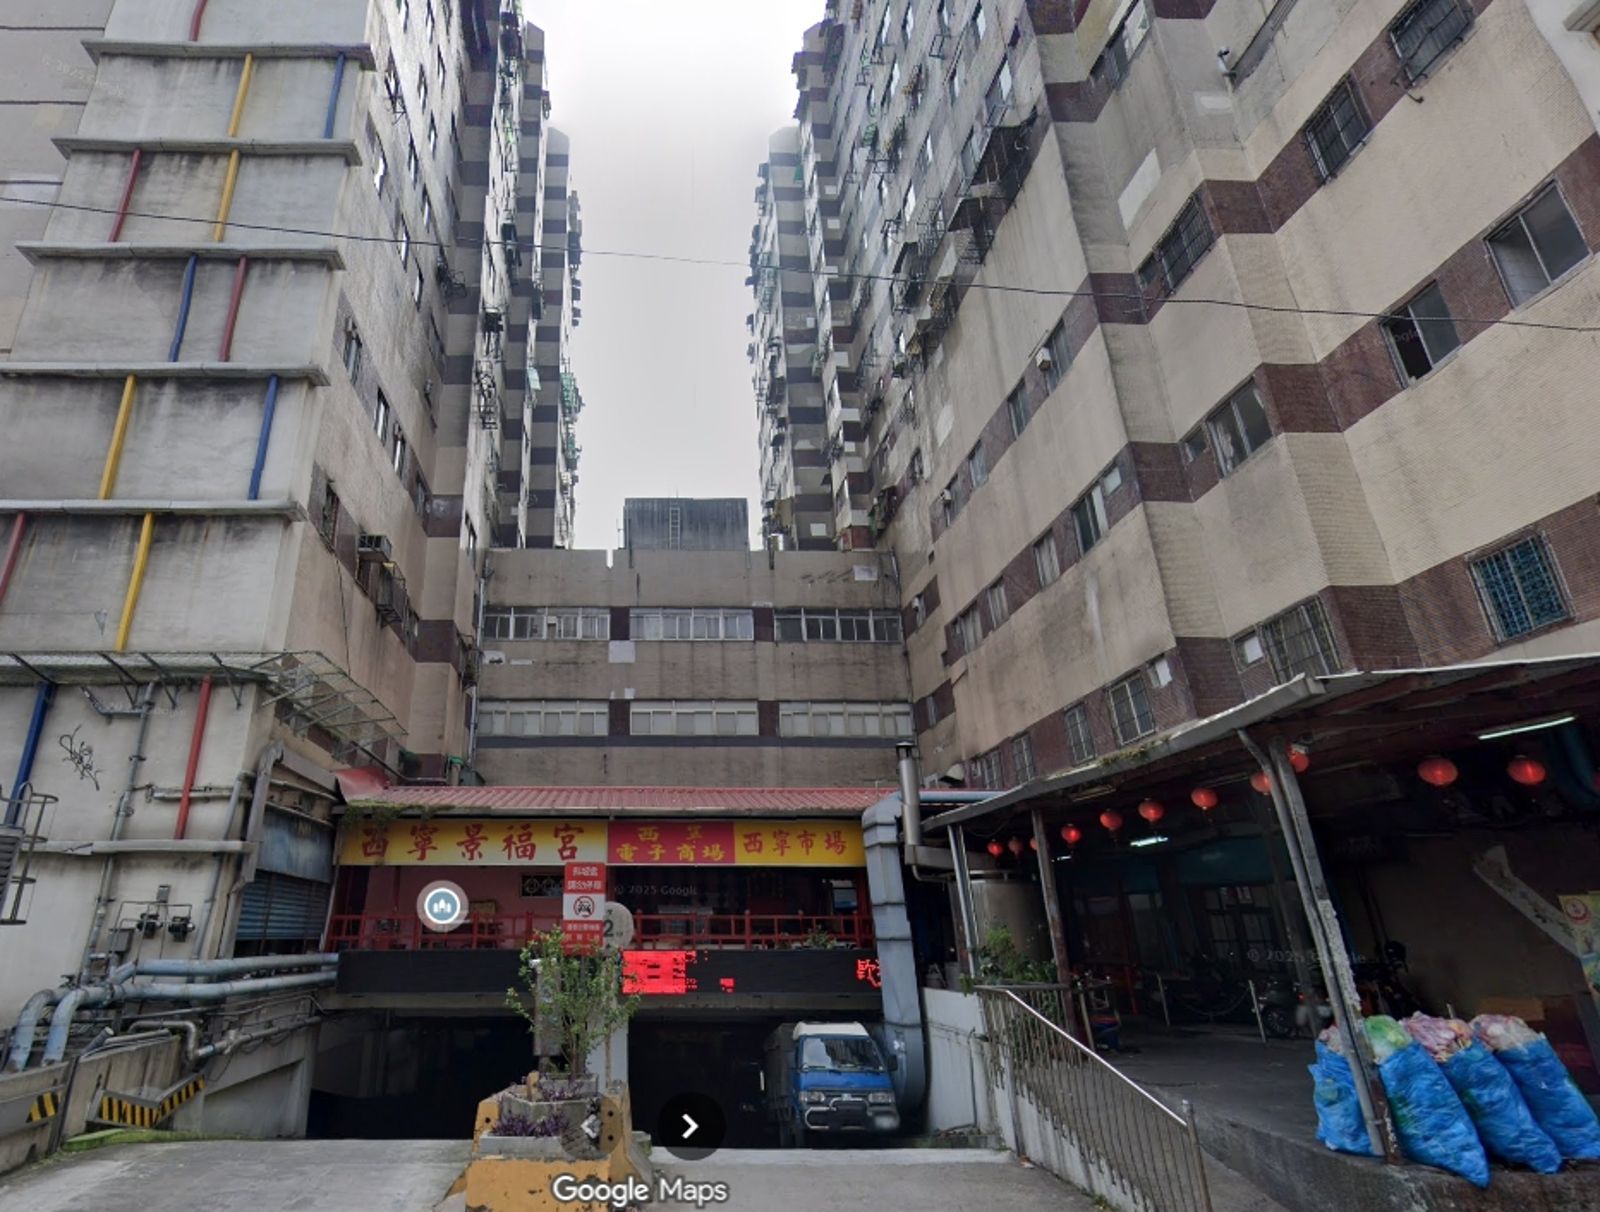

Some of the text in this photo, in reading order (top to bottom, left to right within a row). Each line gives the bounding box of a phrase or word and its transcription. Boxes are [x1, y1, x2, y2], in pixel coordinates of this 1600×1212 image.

[361, 823, 584, 861] 西寧景福宮
[616, 843, 725, 862] 電子商場
[743, 830, 847, 856] 西寧市場
